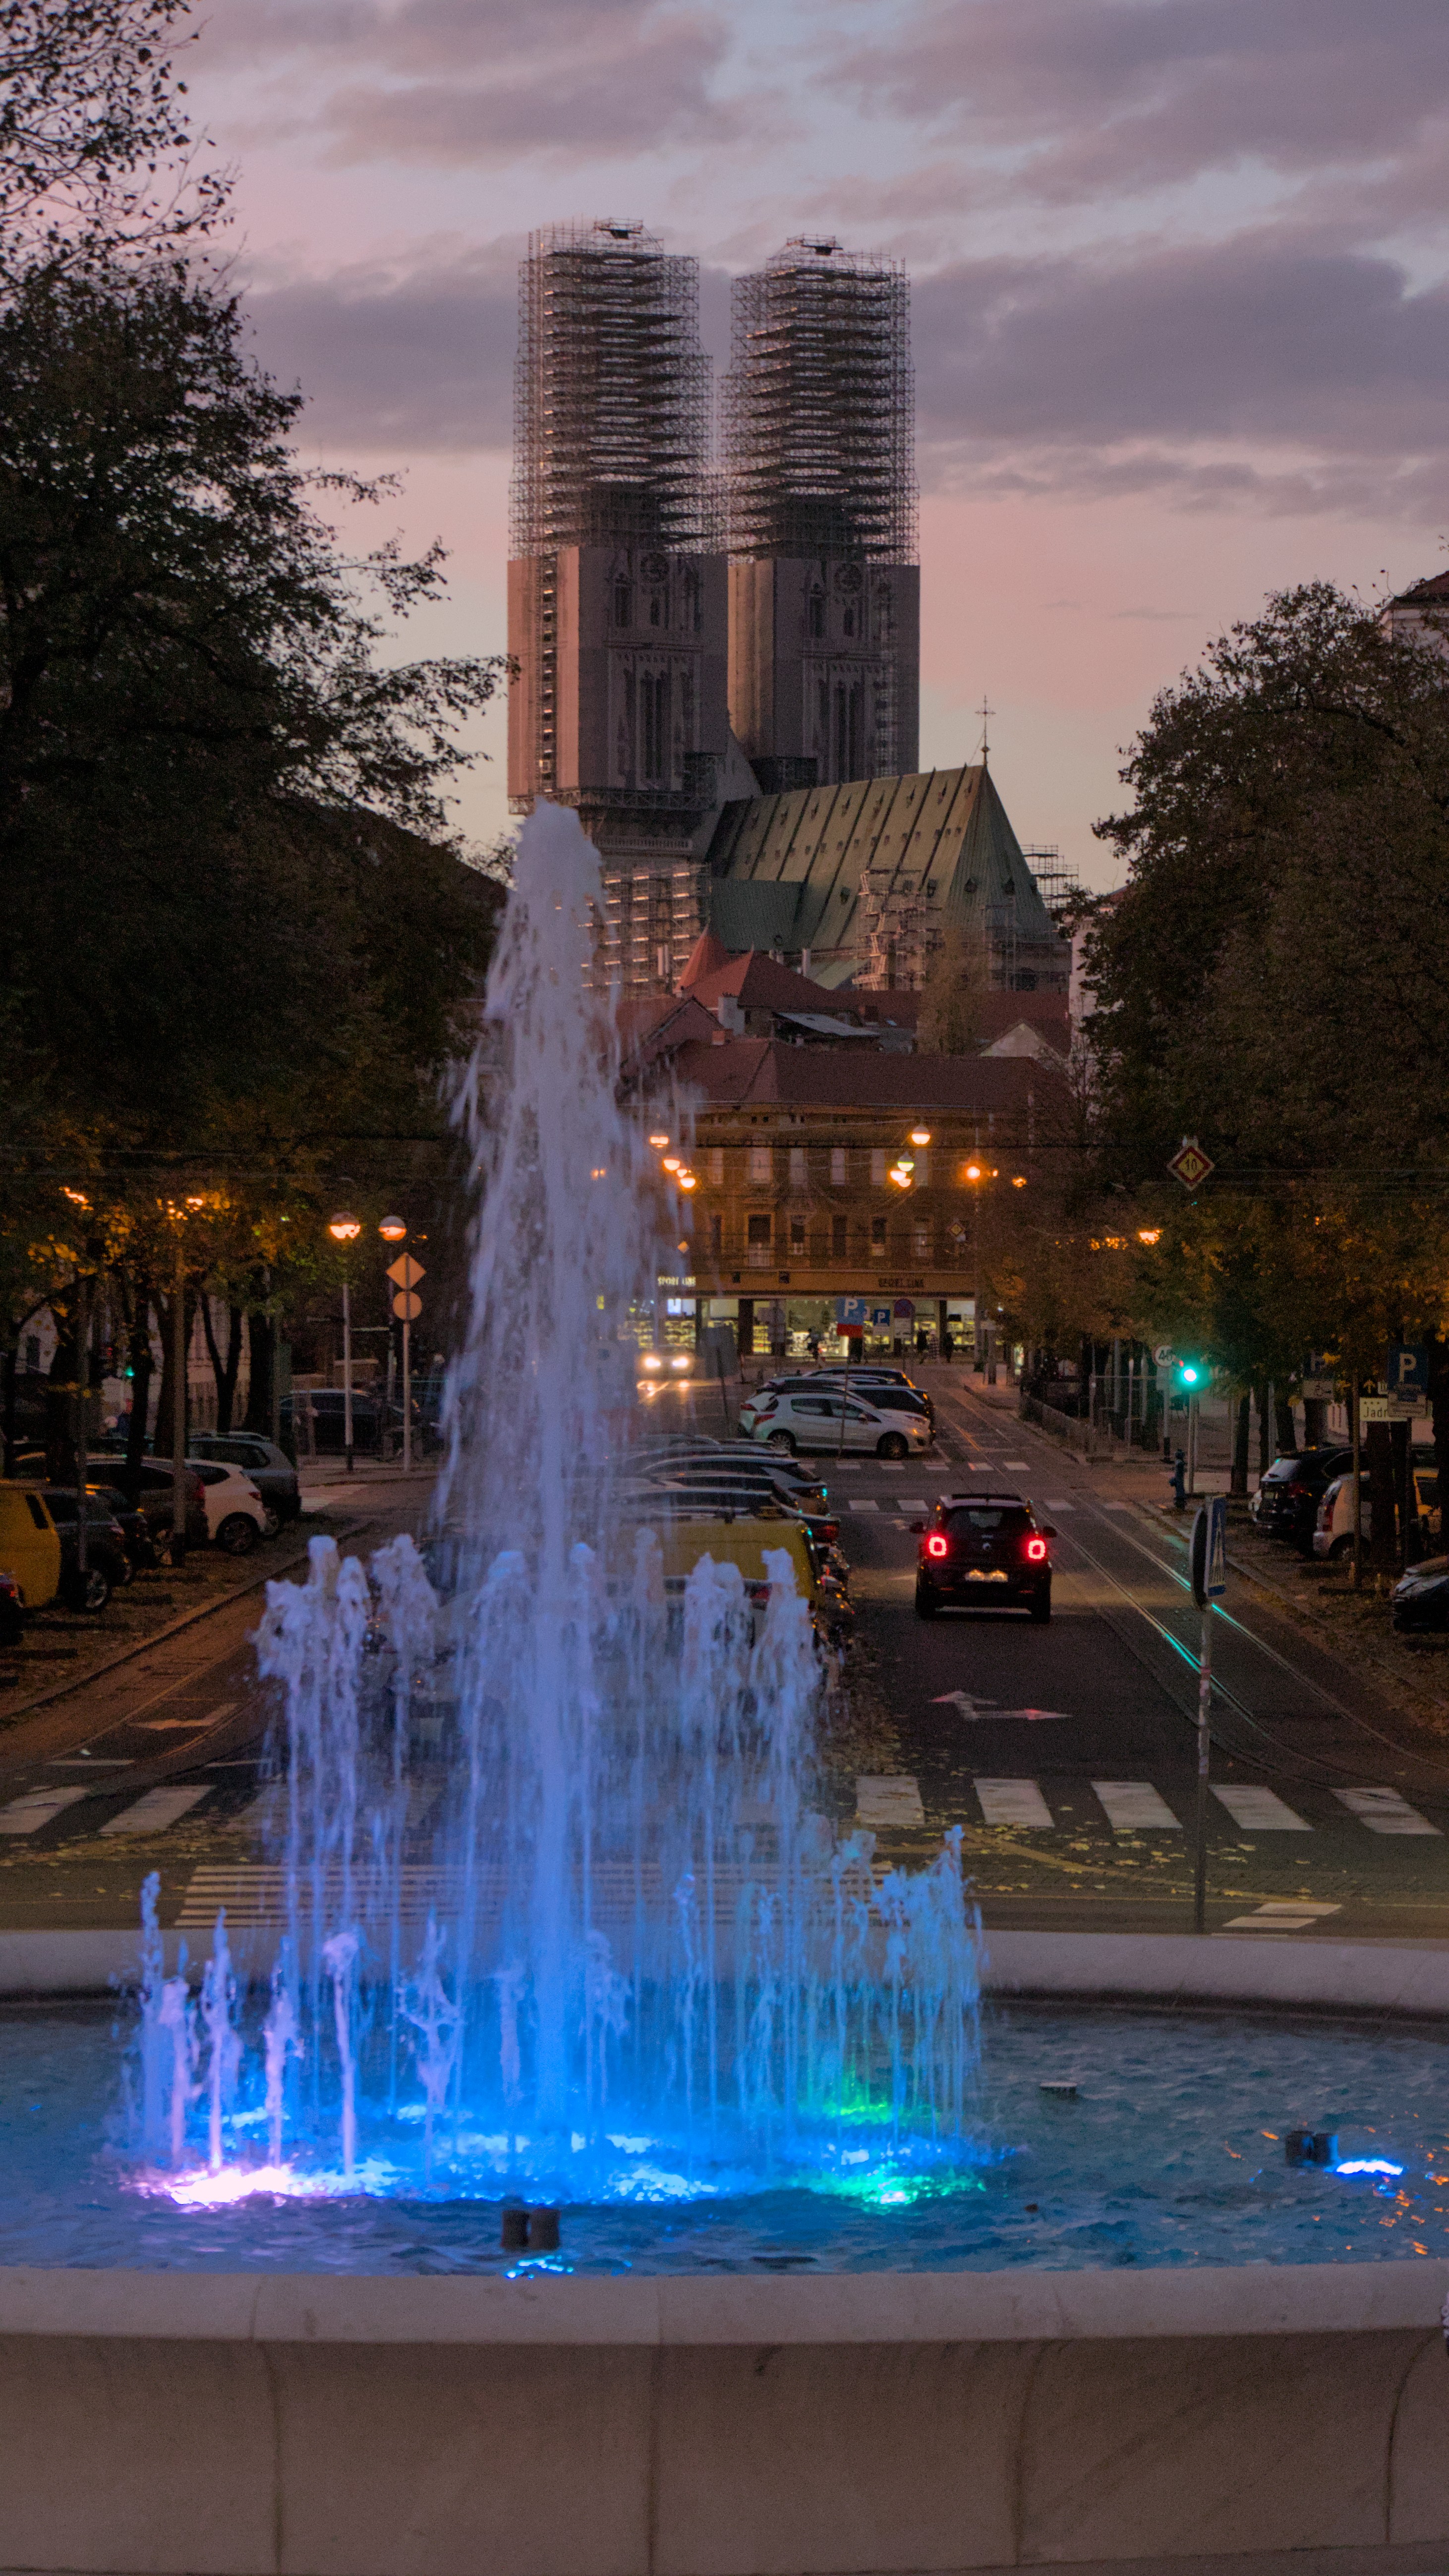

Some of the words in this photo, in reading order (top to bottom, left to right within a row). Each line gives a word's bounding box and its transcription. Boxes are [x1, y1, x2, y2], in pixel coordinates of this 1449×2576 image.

[1185, 1158, 1198, 1171] 10
[844, 1298, 858, 1317] P
[877, 1312, 886, 1323] P
[1399, 1352, 1417, 1382] P
[1364, 1407, 1388, 1418] Jadr
